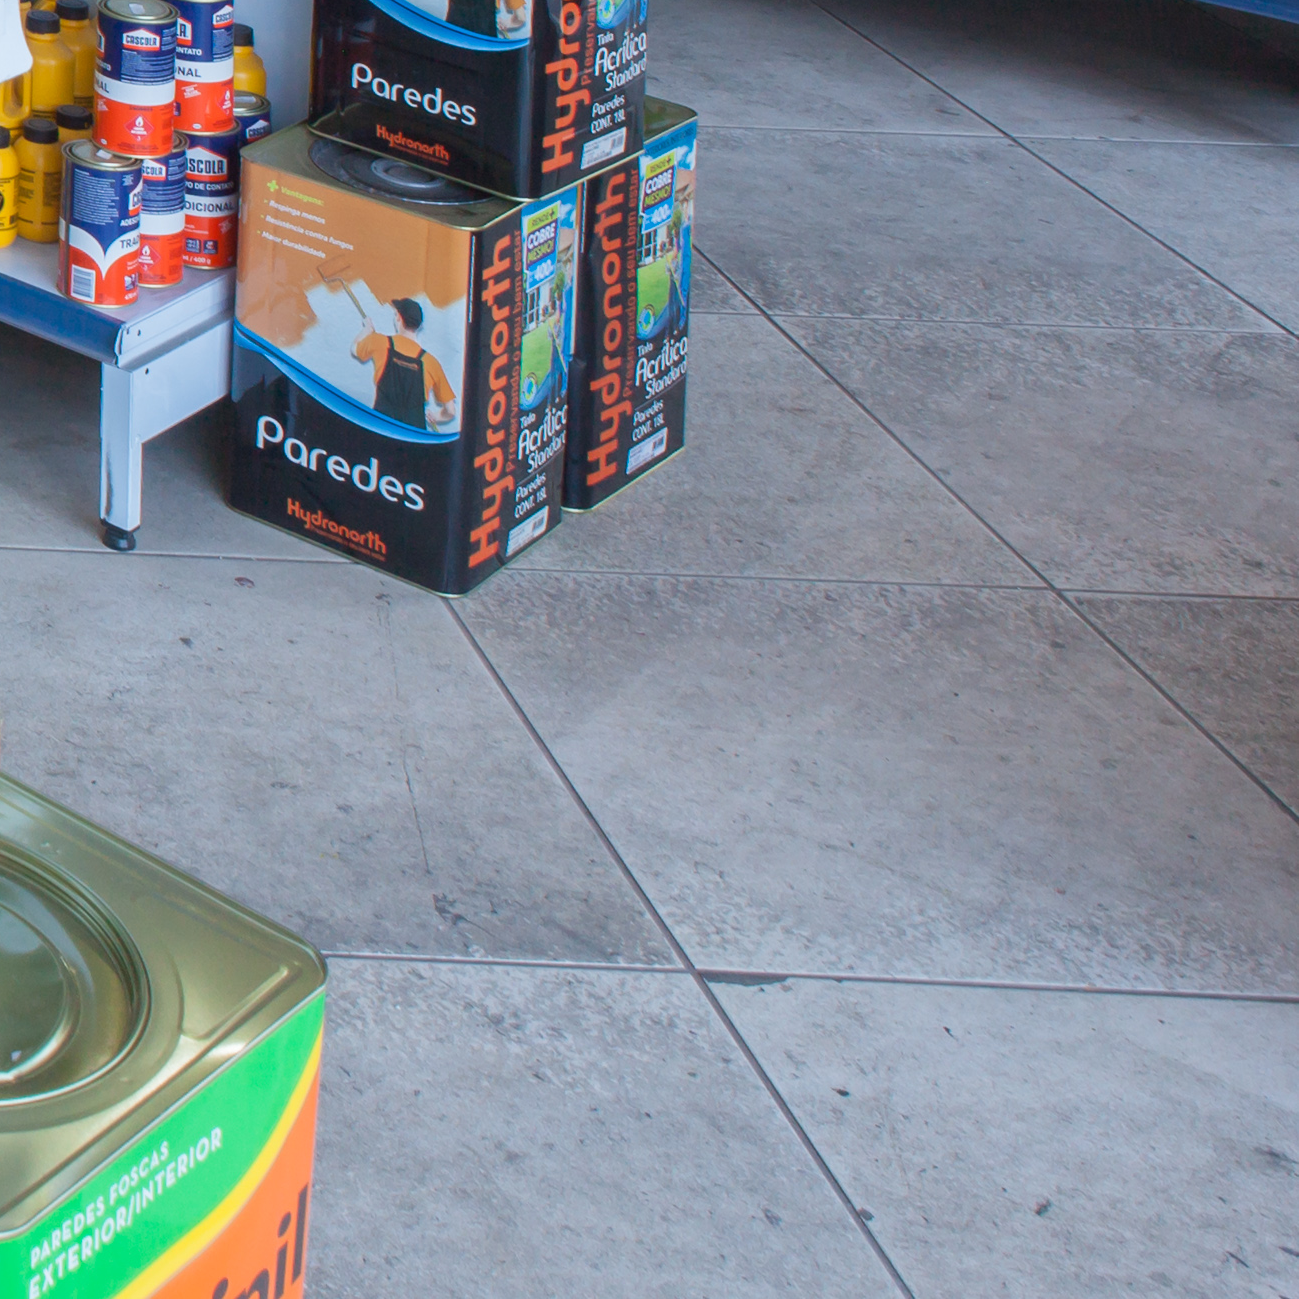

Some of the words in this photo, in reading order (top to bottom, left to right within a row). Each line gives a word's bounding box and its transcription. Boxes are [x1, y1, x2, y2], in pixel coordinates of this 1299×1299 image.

[126, 35, 158, 47] CASCOLA
[595, 31, 647, 76] Acrílica
[597, 32, 614, 46] Tinta
[605, 52, 647, 92] Standard
[351, 62, 476, 126] Paredes
[592, 95, 625, 117] Paredes
[591, 115, 612, 134] CONT.
[614, 109, 626, 123] 18L
[376, 124, 449, 161] Hydronorth
[206, 182, 234, 190] CONTATO
[628, 168, 638, 208] estar
[645, 169, 673, 194] COBRE
[268, 200, 302, 219] Respinga
[303, 210, 326, 225] menos
[625, 210, 637, 248] bem
[261, 231, 280, 244] Maior
[281, 236, 326, 258] durabilidade
[265, 215, 301, 233] Resistência
[303, 225, 326, 239] contra
[328, 233, 355, 251] fungos
[527, 223, 556, 247] COBRE
[512, 275, 522, 315] bem
[586, 172, 632, 486] Hydronorth
[635, 337, 688, 387] Acrílica
[645, 355, 687, 399] Standard
[468, 234, 515, 568] Hydronorth
[633, 400, 664, 426] Paredes
[632, 422, 653, 442] CONT.
[256, 416, 424, 511] Paredes
[516, 472, 546, 502] Paredes
[514, 497, 534, 519] CONT.
[286, 498, 386, 556] Hydronorth
[28, 1126, 222, 1299] EXTERIOR/INTERIOR
[29, 1196, 106, 1269] PAREDES
[108, 1141, 170, 1202] FOSCAS
